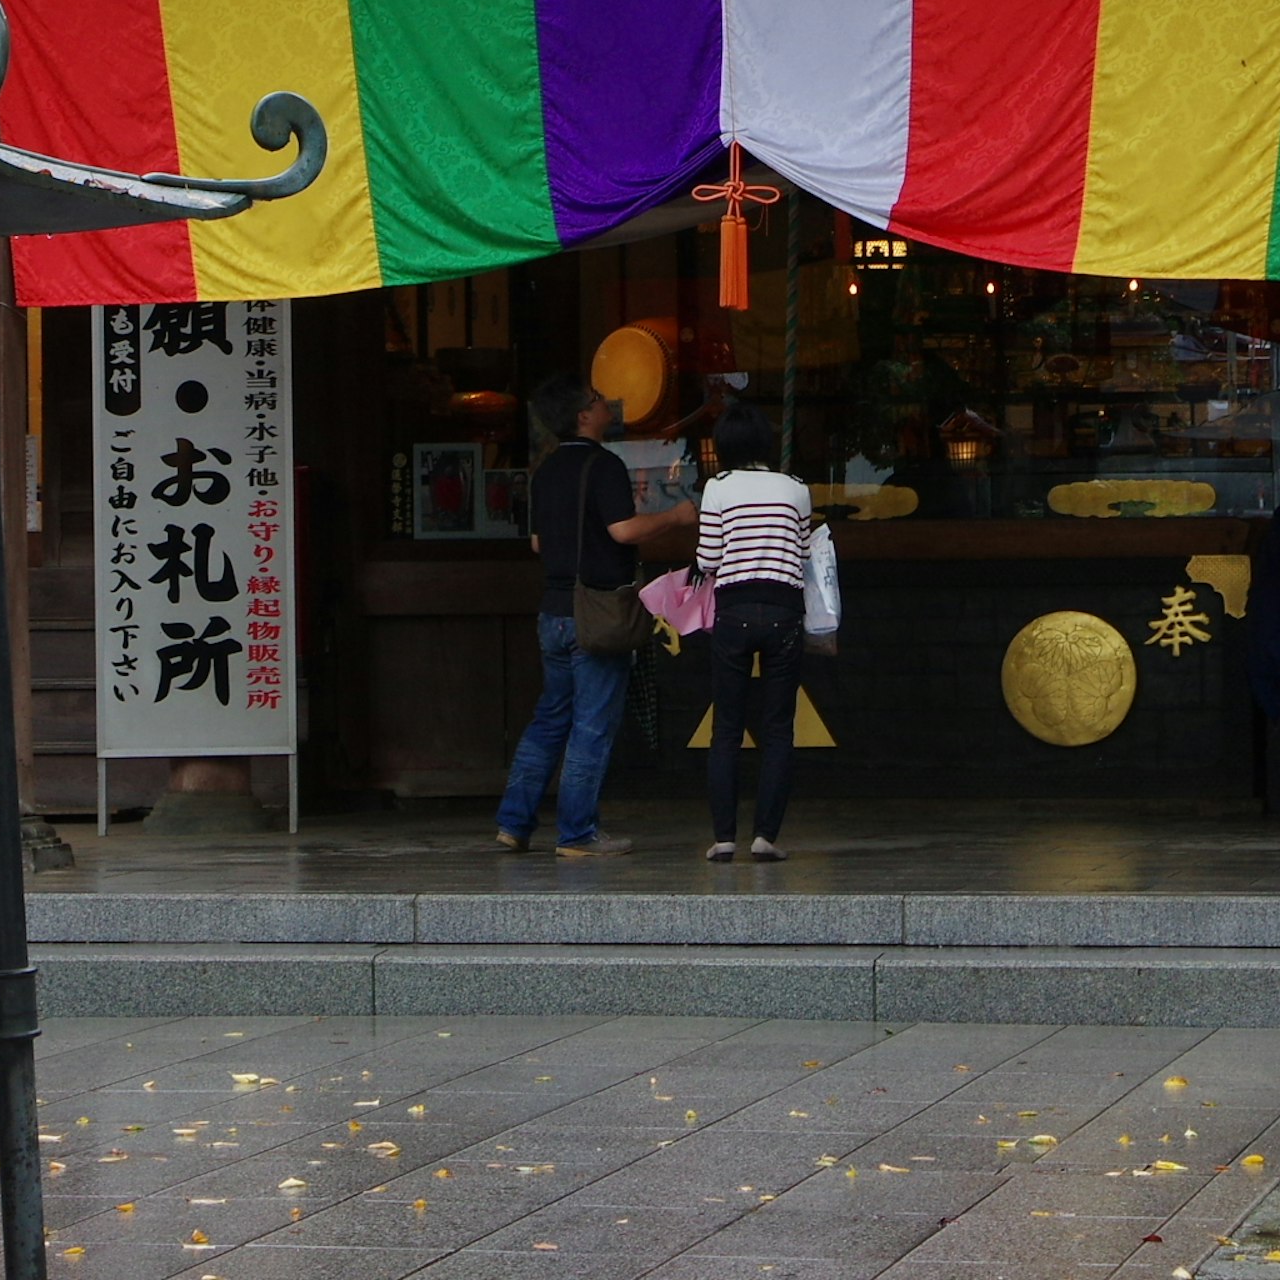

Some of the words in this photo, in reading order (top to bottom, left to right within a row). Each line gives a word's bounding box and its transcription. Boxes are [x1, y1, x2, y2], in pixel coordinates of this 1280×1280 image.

[108, 429, 142, 702] ご自由にお入り下さい
[1143, 583, 1213, 657] 奉
